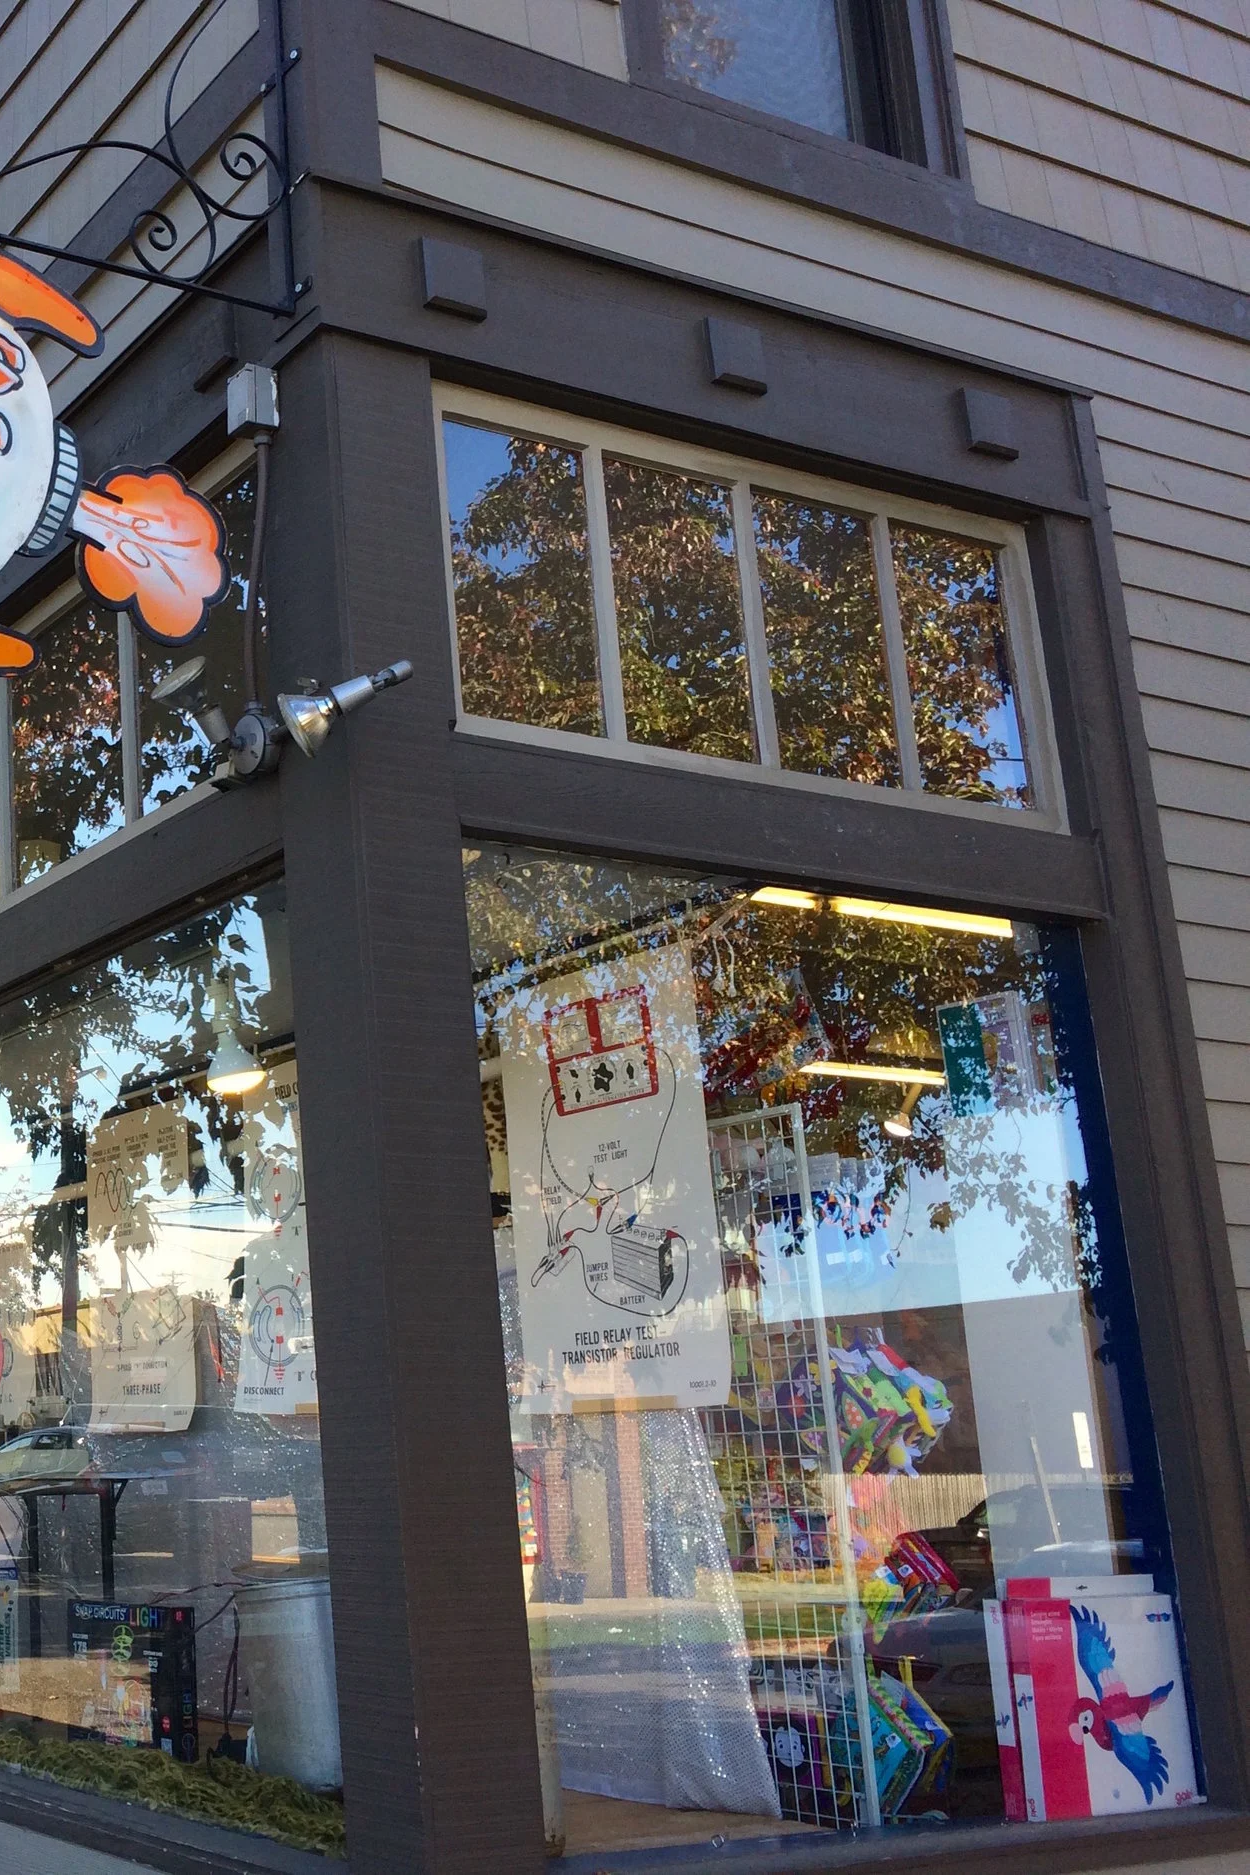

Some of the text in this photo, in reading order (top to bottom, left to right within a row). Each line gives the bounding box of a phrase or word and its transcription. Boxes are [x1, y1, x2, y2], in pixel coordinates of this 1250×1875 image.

[598, 1140, 621, 1151] 12-VOLT
[594, 1149, 628, 1164] TEST LIGHT
[544, 1185, 561, 1195] RELAY
[586, 1261, 608, 1273] JUMPER
[590, 1272, 608, 1282] WIRES
[620, 1295, 646, 1305] BATTERY
[575, 1330, 600, 1346] FIELD
[603, 1327, 631, 1345] RELAY
[562, 1342, 680, 1365] TRANSISTOR REGULATOR
[122, 1383, 161, 1396] THREE-PHASE
[243, 1386, 285, 1396] DISCONNECT
